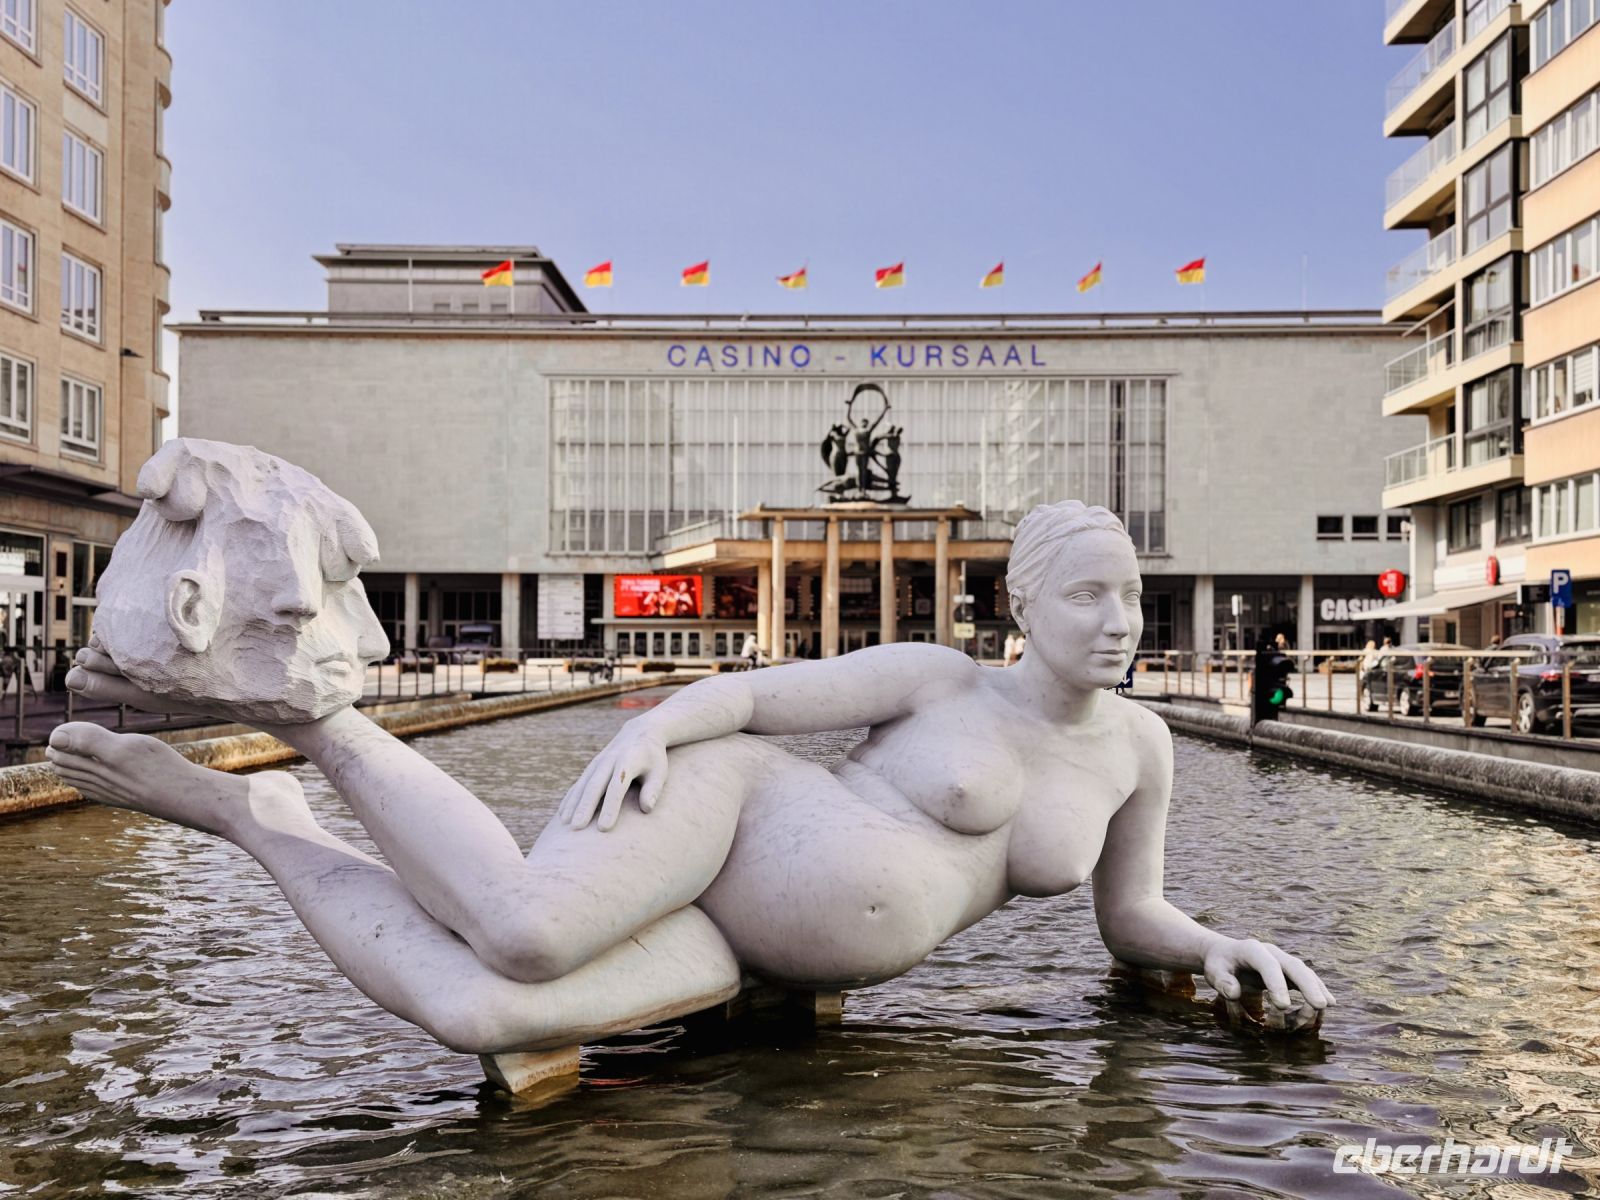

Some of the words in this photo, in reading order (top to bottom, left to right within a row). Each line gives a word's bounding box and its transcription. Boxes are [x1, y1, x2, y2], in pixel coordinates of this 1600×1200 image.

[667, 344, 811, 368] CASINO
[869, 344, 1047, 368] KURSAAL
[1552, 571, 1569, 594] P
